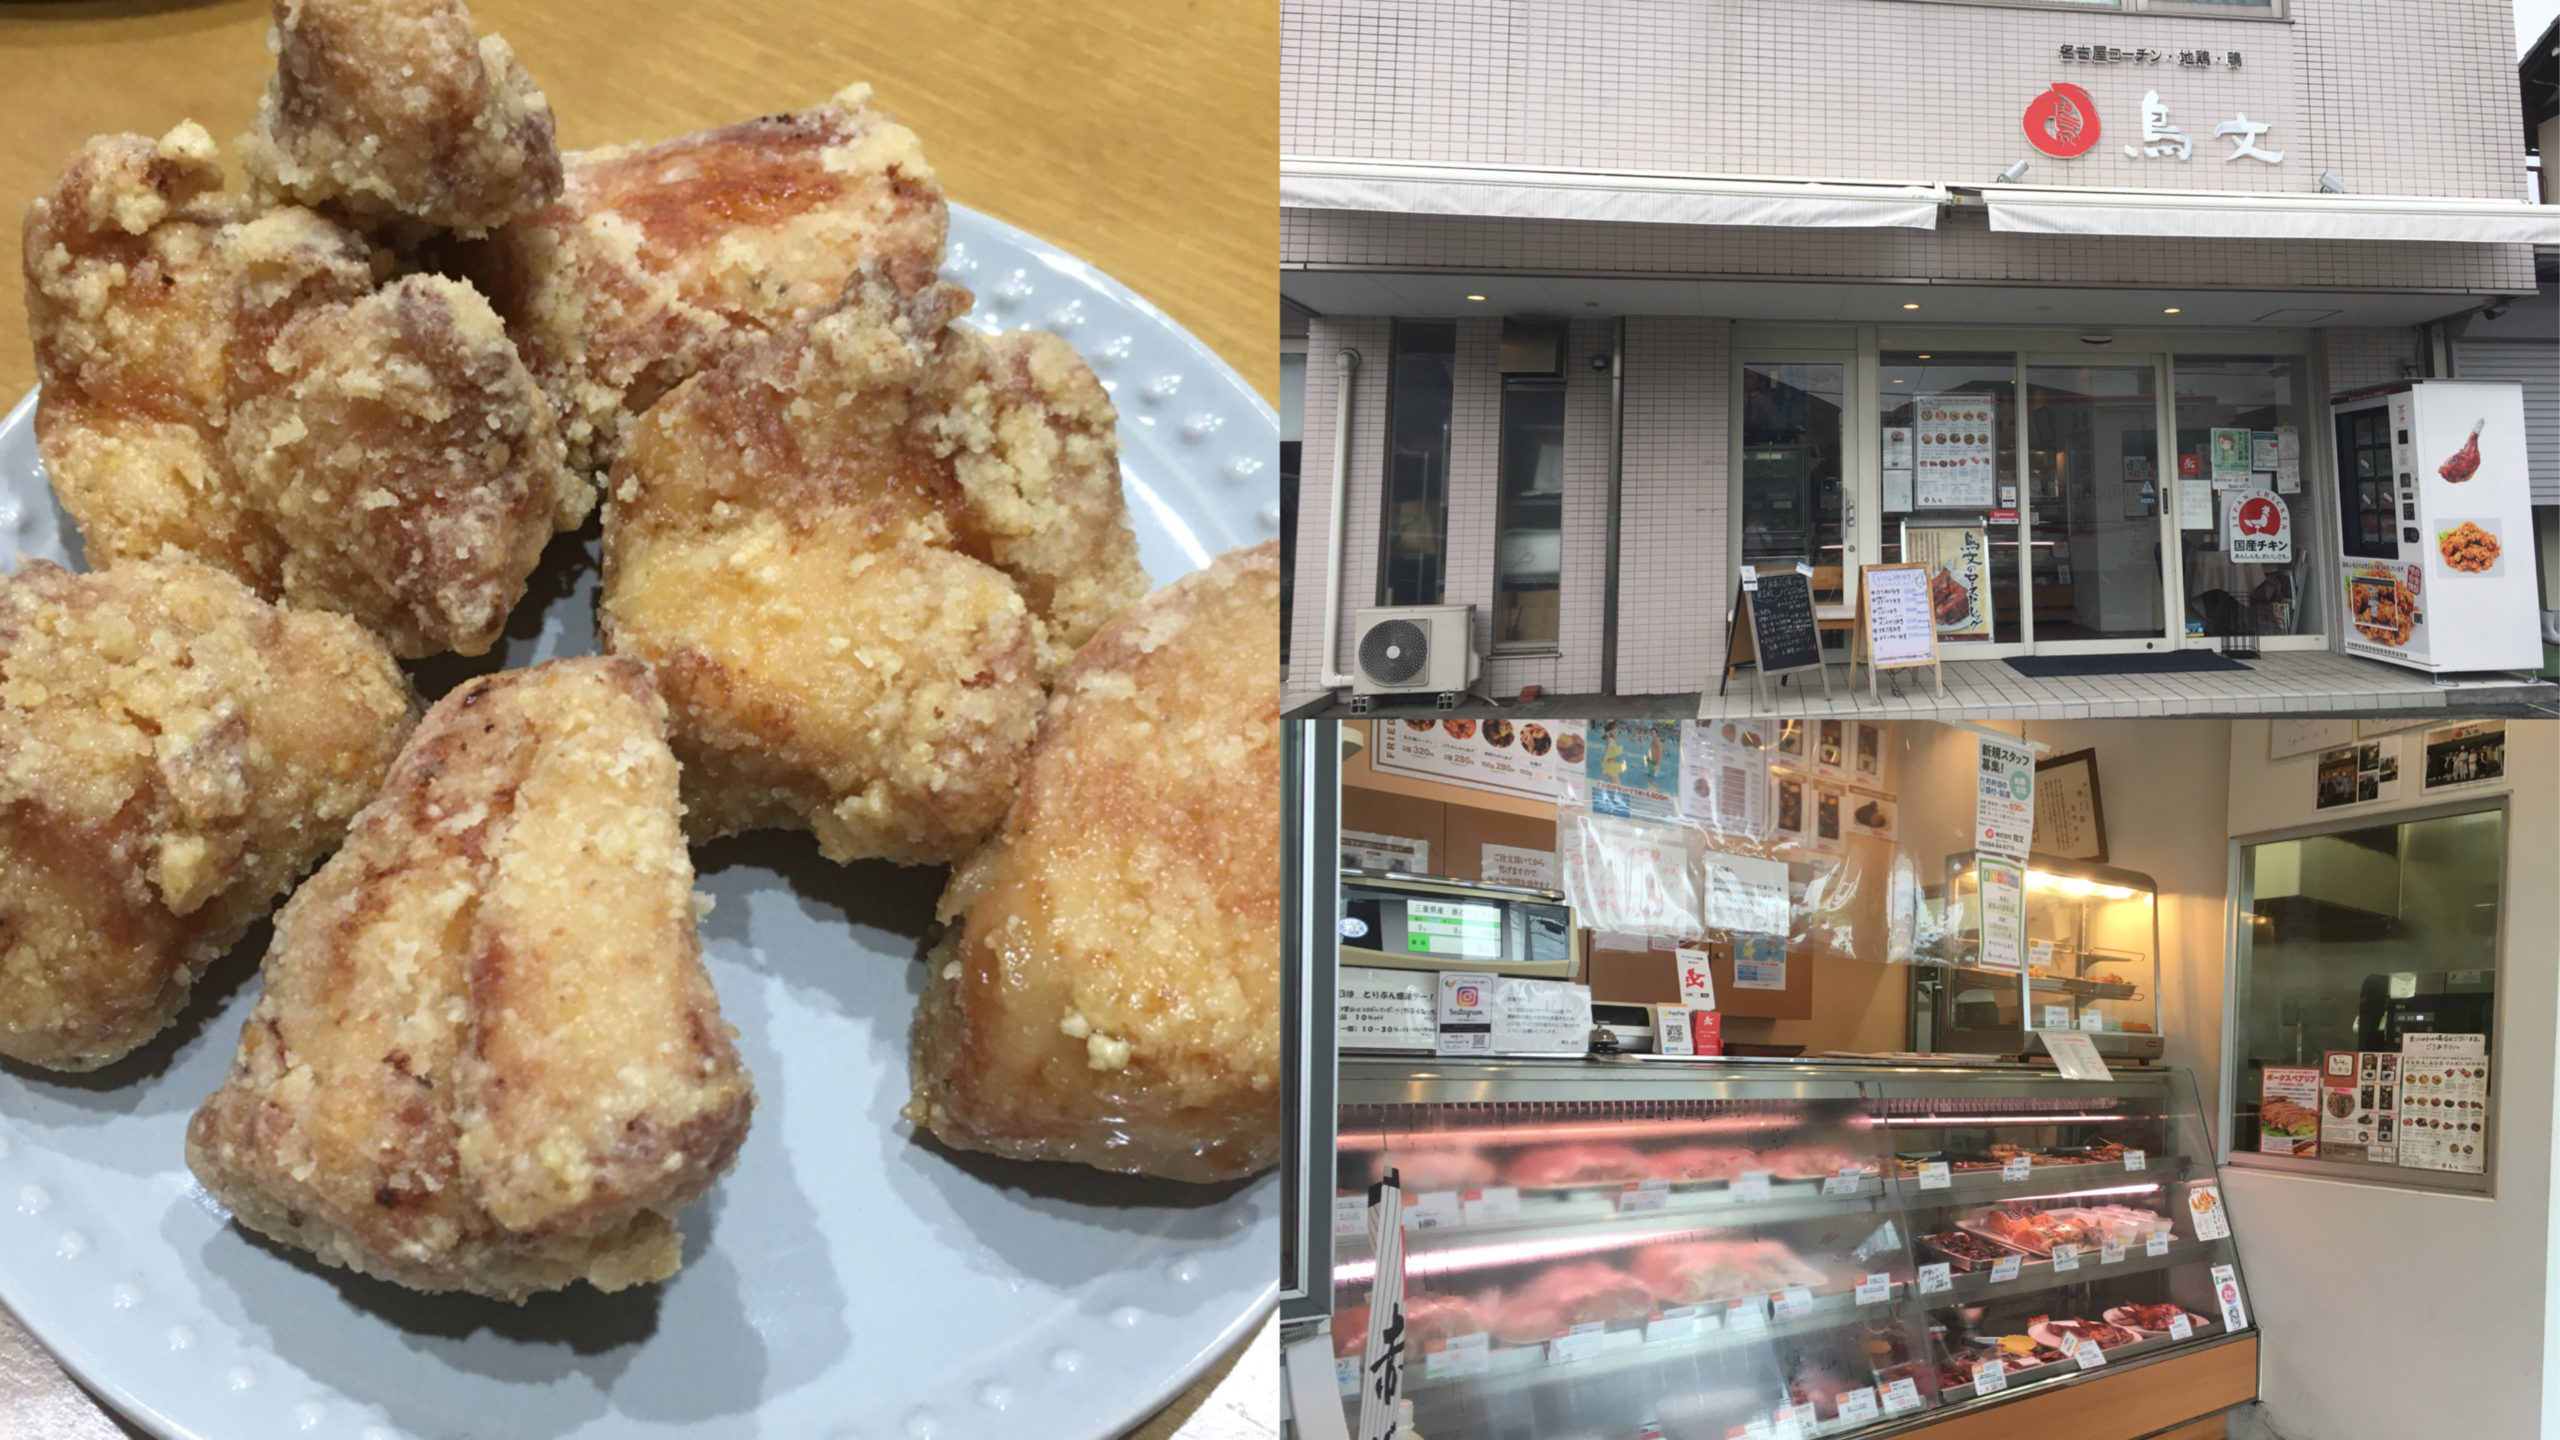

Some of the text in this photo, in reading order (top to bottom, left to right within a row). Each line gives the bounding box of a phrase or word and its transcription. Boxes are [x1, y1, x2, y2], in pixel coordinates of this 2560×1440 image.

[2059, 44, 2243, 70] 名古屋コーチン・地鶏・鴨
[2124, 89, 2284, 164] 鳥文
[2232, 495, 2249, 528] JAPAN
[2256, 490, 2288, 530] CHICKEN
[2234, 539, 2288, 552] 国産チキン
[1982, 743, 2030, 766] 新規スタッフ
[1449, 1008, 1484, 1018] Instagram
[1668, 1010, 1686, 1018] PayPay
